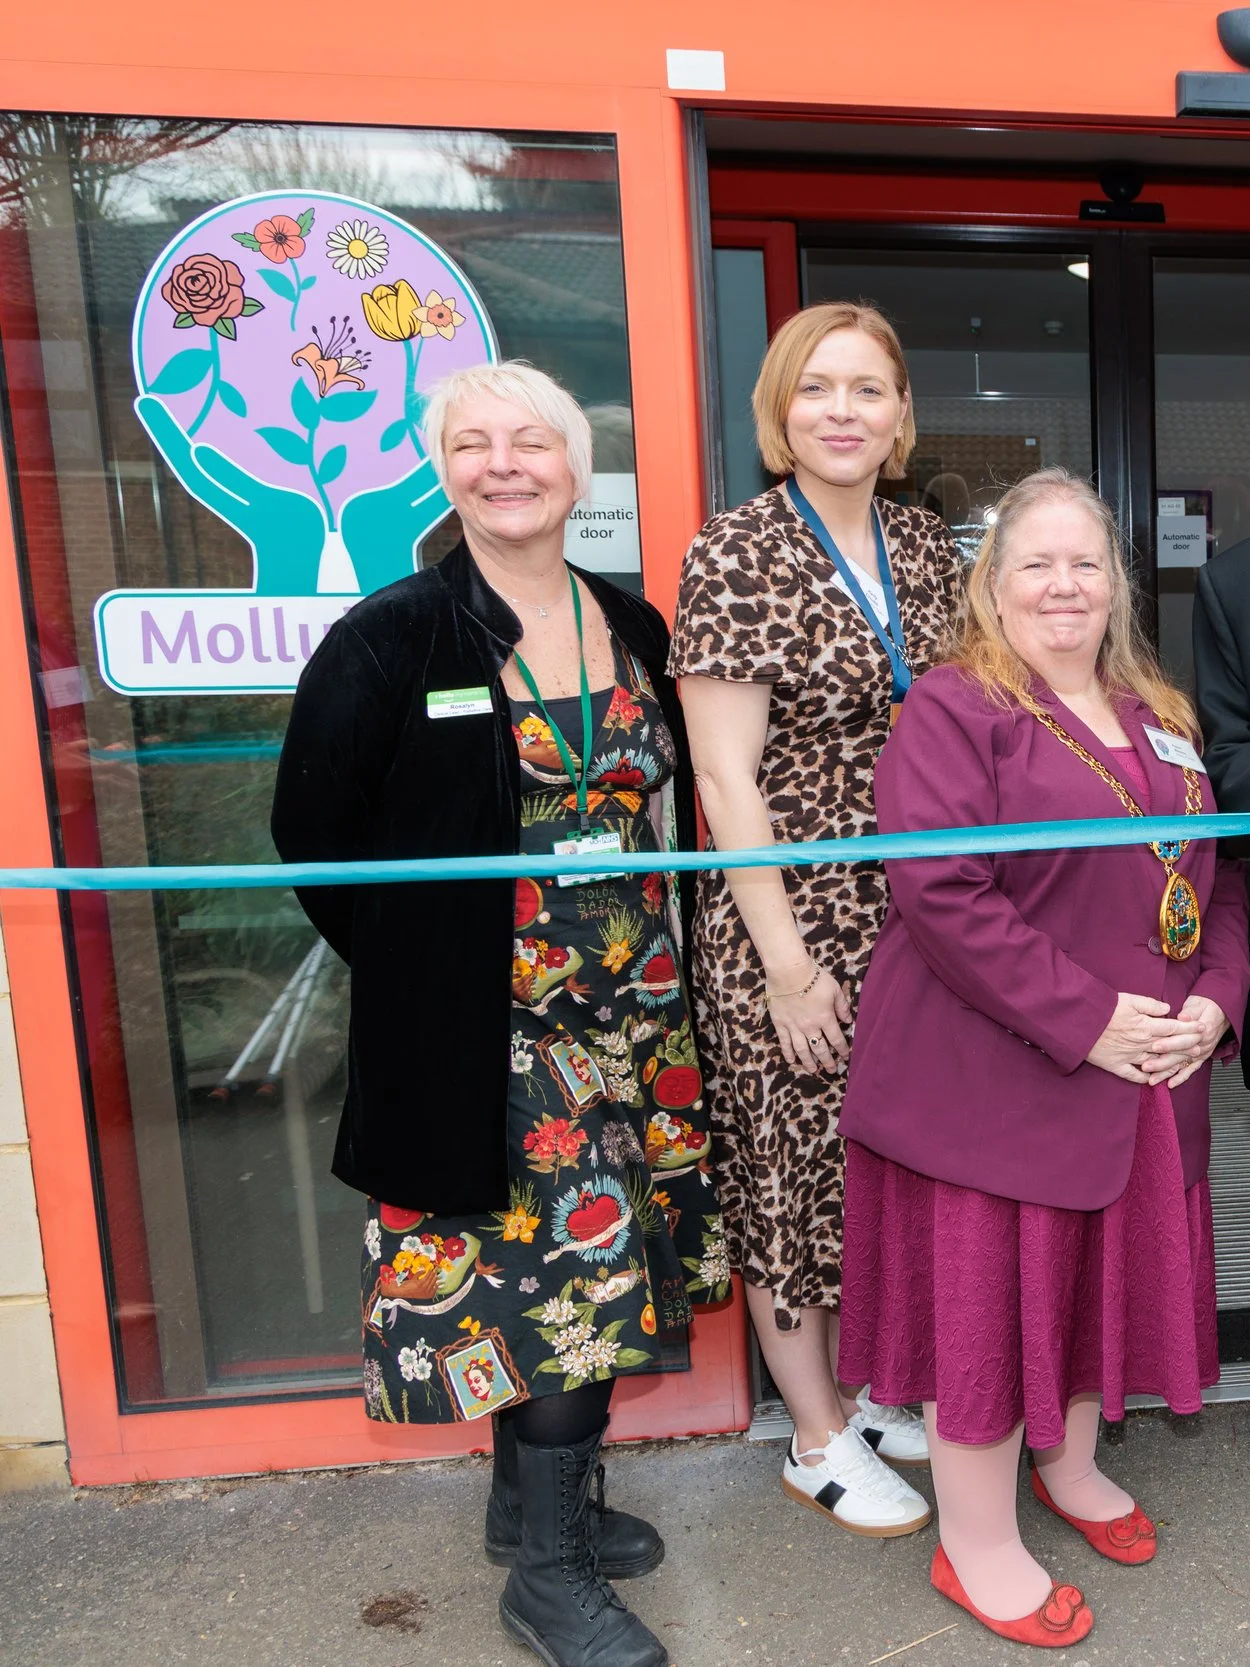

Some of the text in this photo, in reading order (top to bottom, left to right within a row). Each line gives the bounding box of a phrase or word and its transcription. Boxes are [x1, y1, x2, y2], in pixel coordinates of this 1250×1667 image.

[567, 508, 634, 520] utomatic
[580, 527, 604, 539] door
[1162, 533, 1200, 541] Automatic
